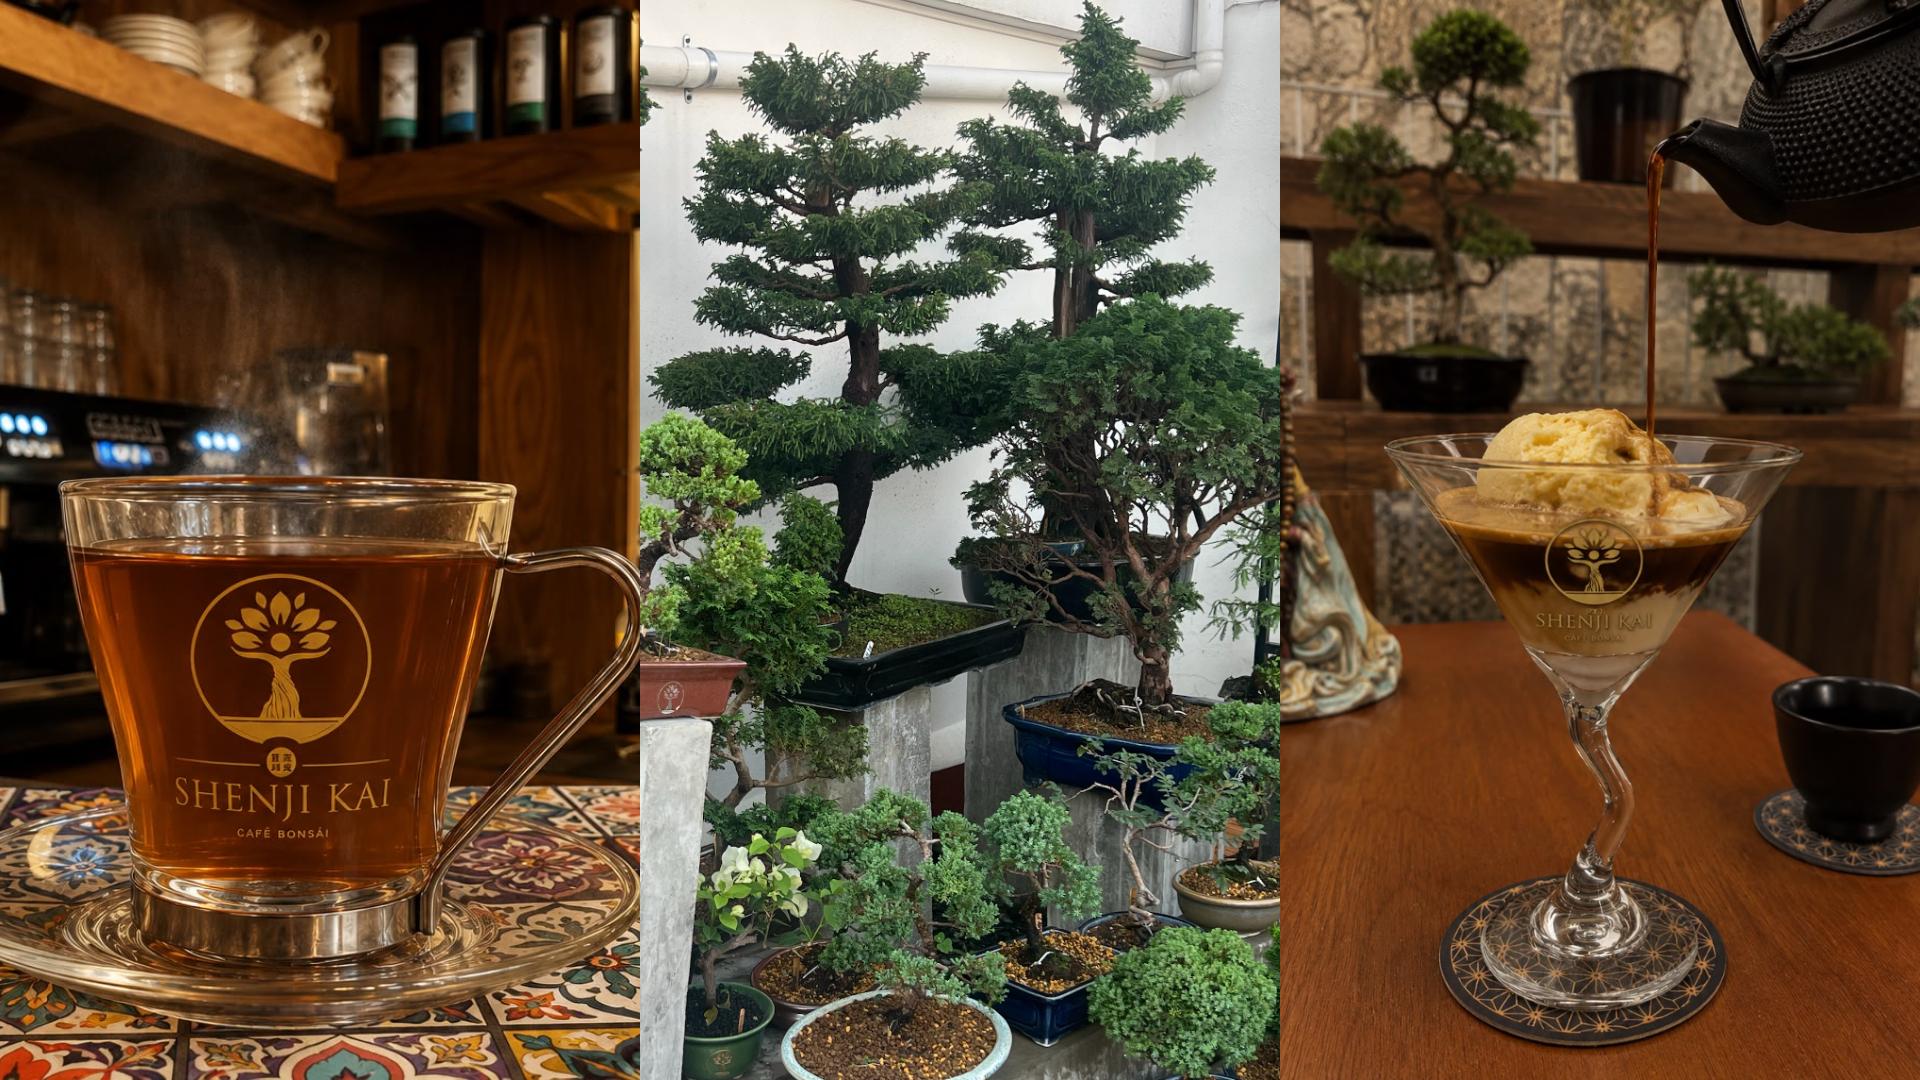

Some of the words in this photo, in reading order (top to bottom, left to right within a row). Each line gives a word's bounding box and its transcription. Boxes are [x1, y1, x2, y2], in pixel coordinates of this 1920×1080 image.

[1536, 612, 1609, 632] SHENJI
[1619, 612, 1653, 631] KAI
[175, 776, 310, 822] SHENJI
[328, 777, 391, 813] KAI
[237, 826, 271, 839] CAFÉ
[278, 825, 329, 839] BONSÁI
